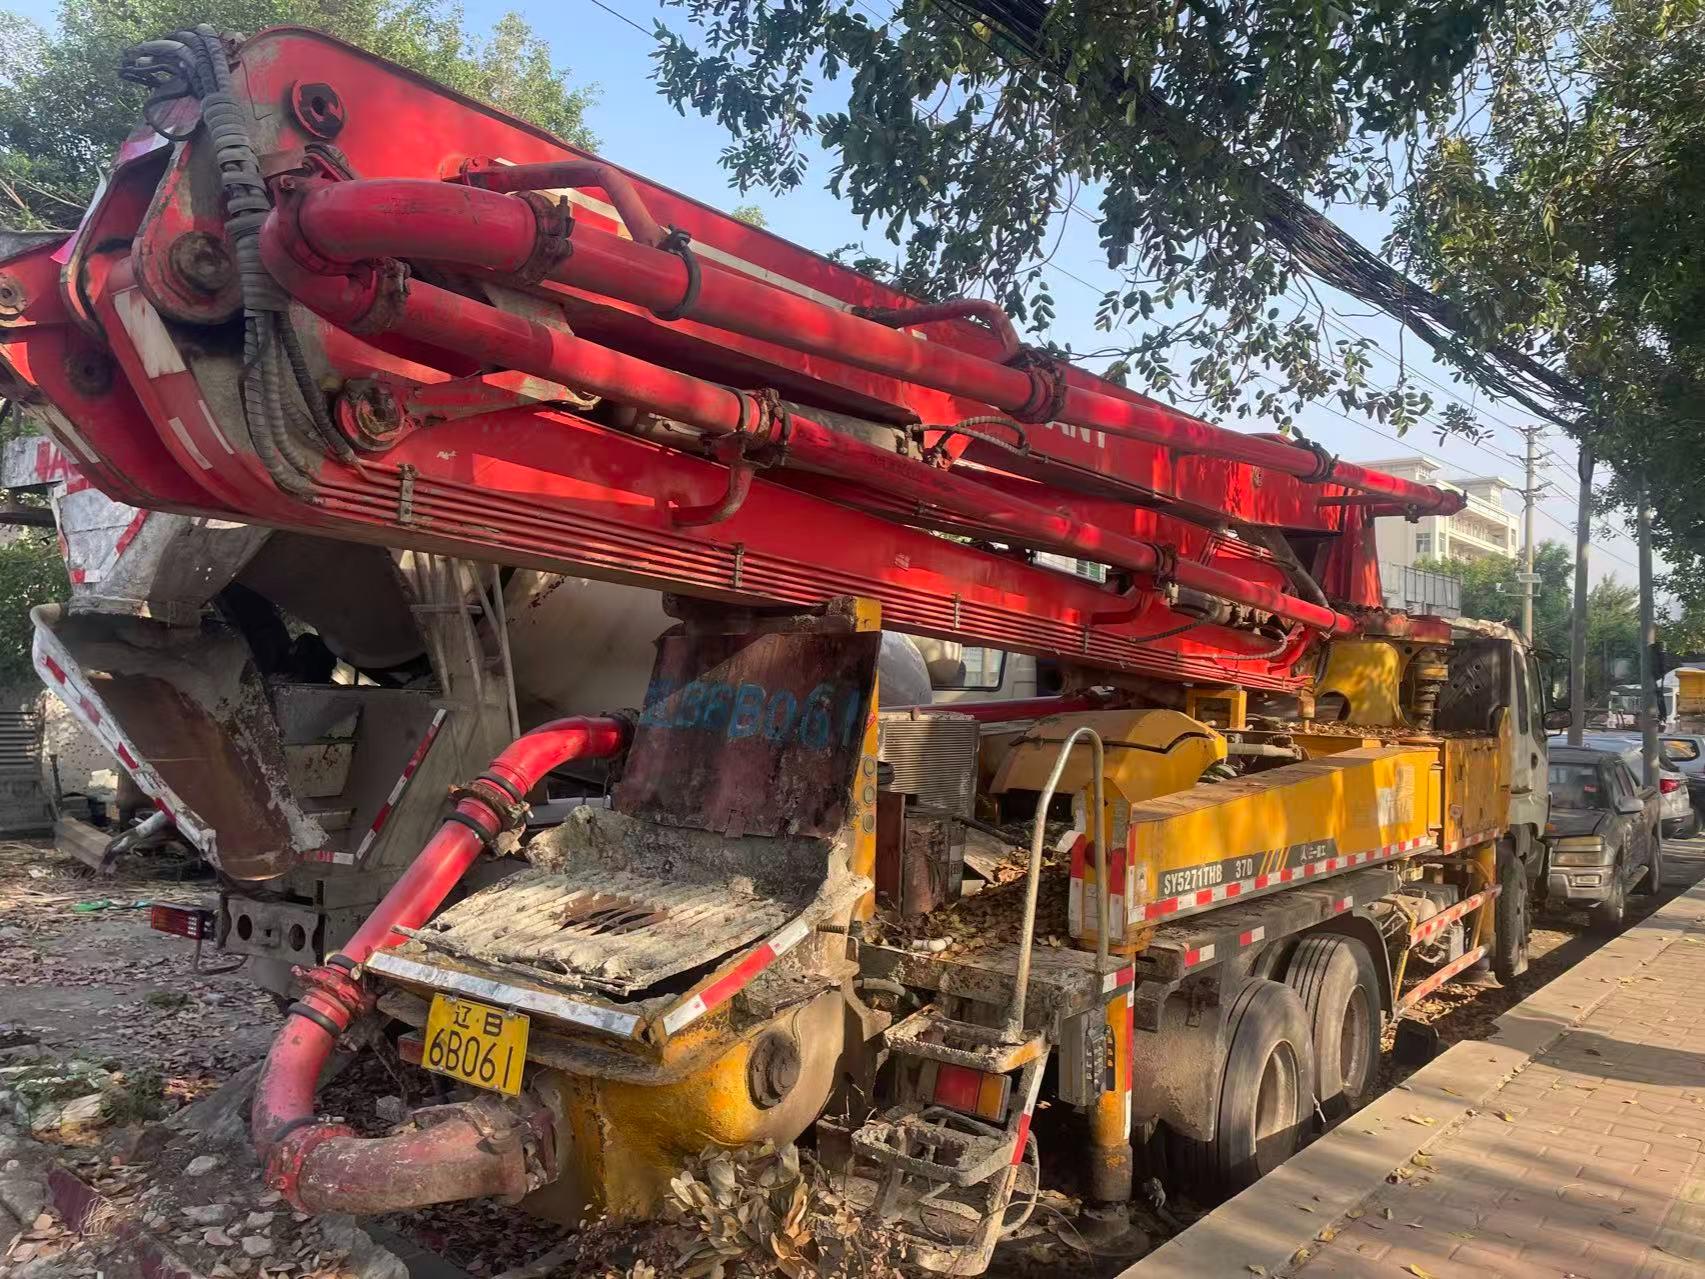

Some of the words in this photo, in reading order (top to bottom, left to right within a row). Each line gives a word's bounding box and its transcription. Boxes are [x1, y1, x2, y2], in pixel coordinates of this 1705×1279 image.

[1163, 864, 1223, 895] SY5271THB
[1235, 858, 1253, 879] 370
[429, 1028, 513, 1089] 6B061
